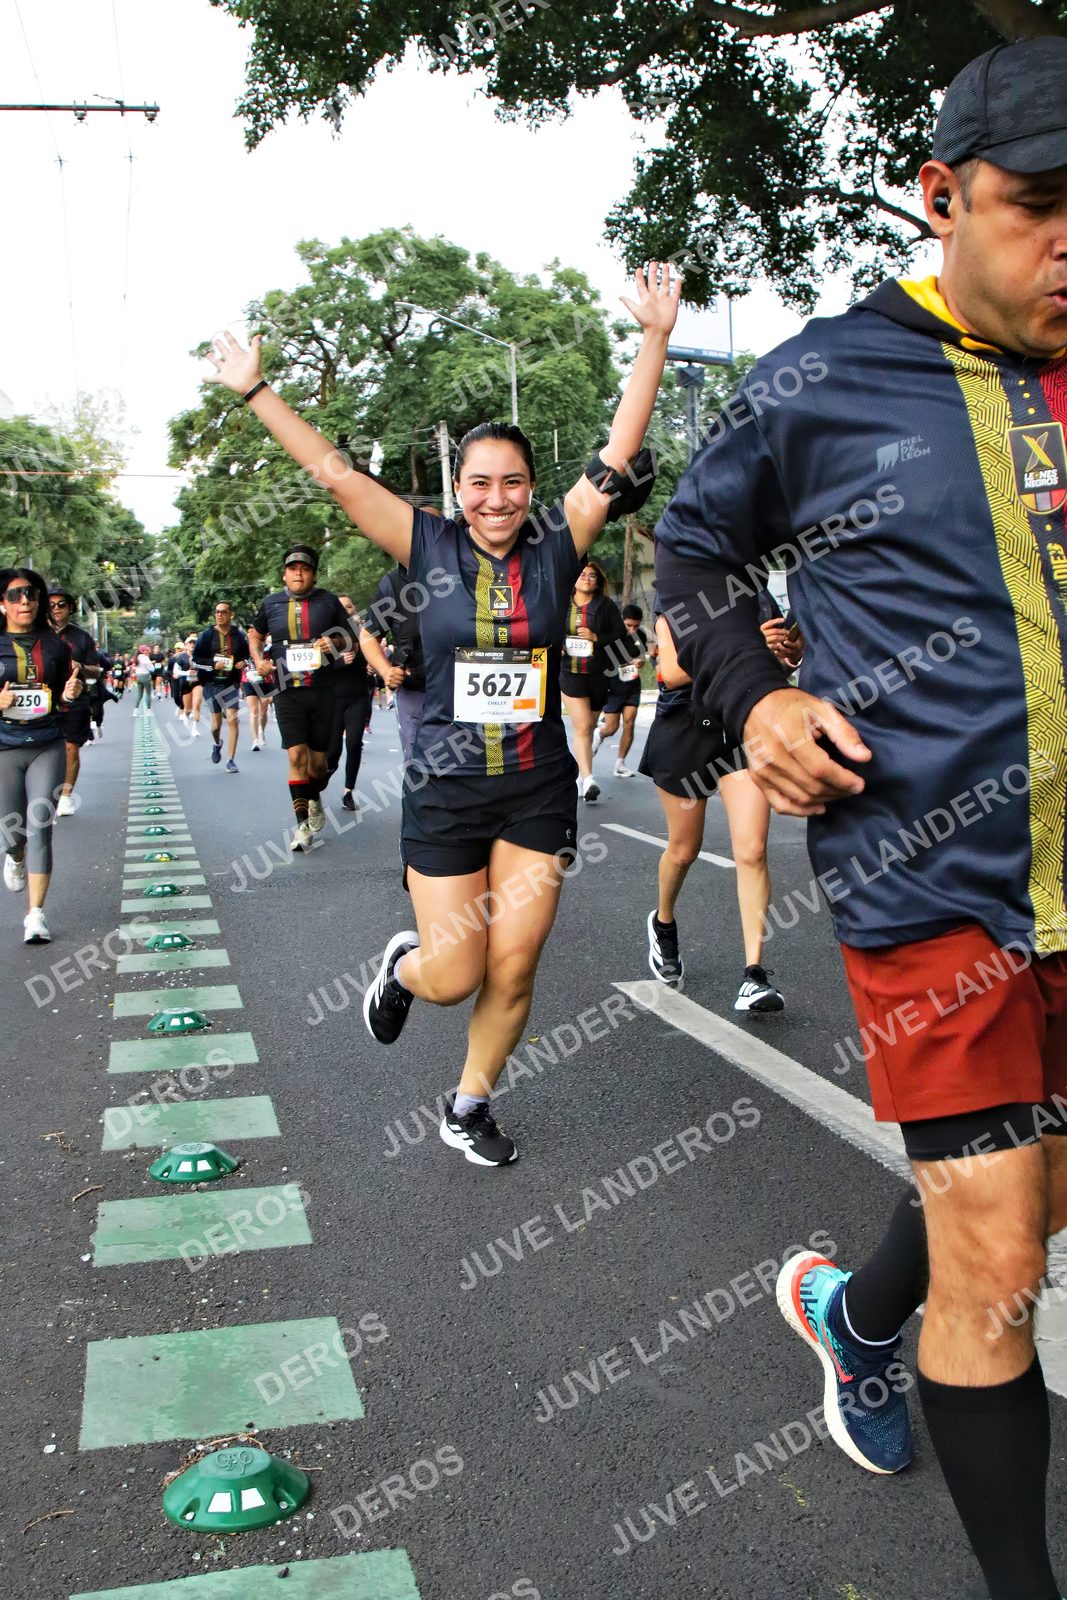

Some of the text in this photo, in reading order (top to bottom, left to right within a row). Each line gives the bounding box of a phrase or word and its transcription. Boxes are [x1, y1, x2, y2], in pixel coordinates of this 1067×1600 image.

[1024, 477, 1058, 489] NEGROS
[292, 651, 314, 662] 1959
[467, 672, 527, 697] 5627
[14, 695, 41, 707] 250
